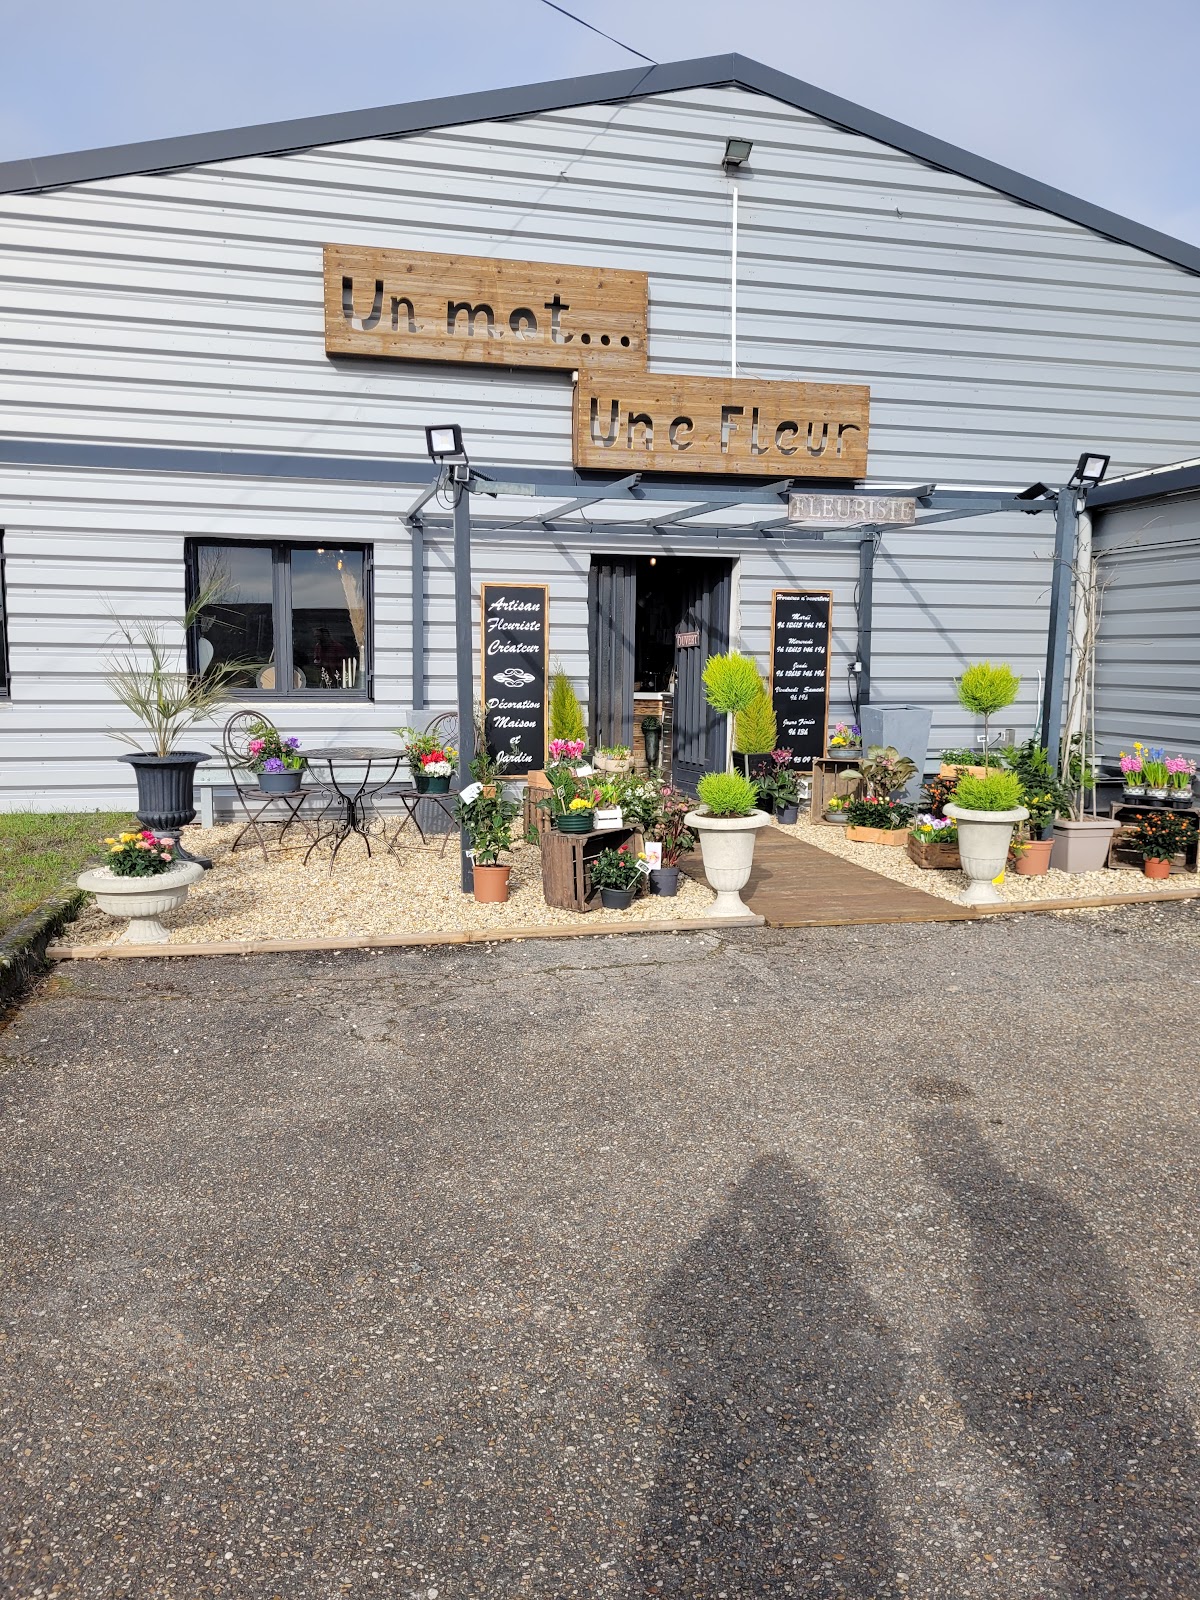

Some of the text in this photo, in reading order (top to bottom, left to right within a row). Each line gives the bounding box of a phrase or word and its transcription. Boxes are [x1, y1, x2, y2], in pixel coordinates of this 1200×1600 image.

[341, 275, 632, 348] Un mot...
[589, 397, 863, 458] Une Fleur
[793, 497, 912, 520] FLEURISTE
[488, 596, 541, 612] Artisan
[487, 617, 541, 633] Fleuriste
[487, 639, 540, 656] Créateur
[677, 634, 698, 647] OUVERT
[487, 697, 541, 709] Décoration
[493, 716, 537, 729] Maison
[509, 735, 522, 744] et
[496, 750, 533, 764] Jardin
